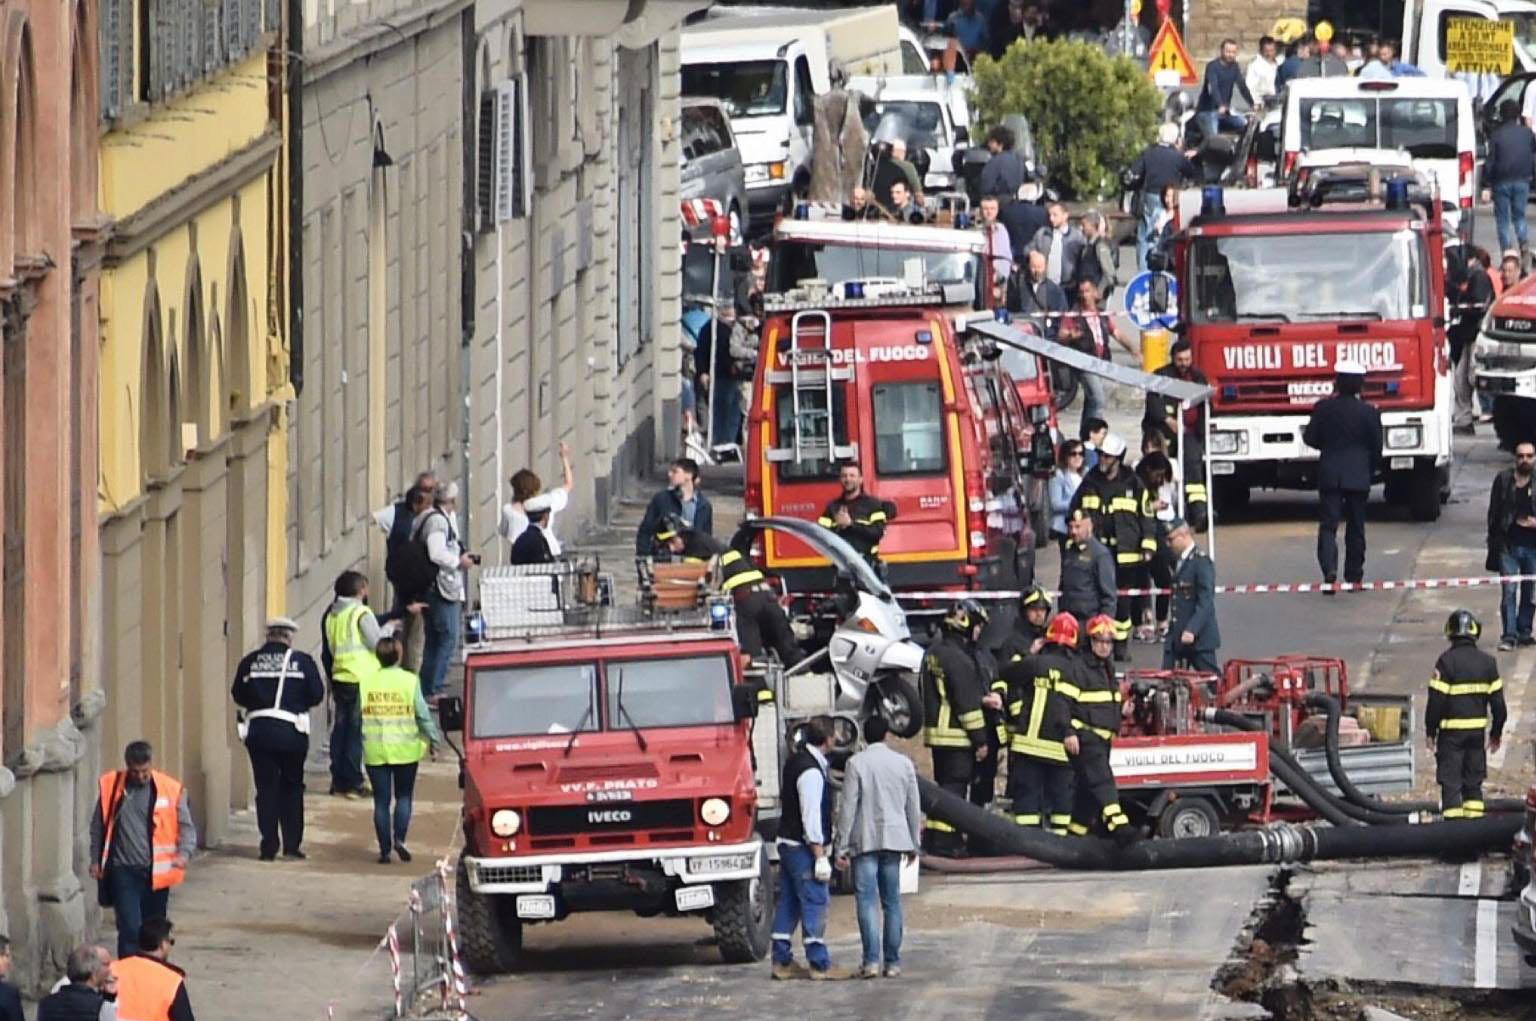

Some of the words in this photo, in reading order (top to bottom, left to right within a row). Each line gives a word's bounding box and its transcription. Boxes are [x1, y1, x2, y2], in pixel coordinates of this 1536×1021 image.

[830, 347, 866, 364] DEL
[869, 344, 929, 362] FUOCO
[1223, 344, 1283, 370] VIGILI
[1291, 342, 1328, 369] DEL
[1335, 341, 1396, 368] FUOCO
[1286, 381, 1335, 396] IVECO
[1124, 751, 1156, 767] VIGILI
[1160, 752, 1182, 766] DEL
[1185, 751, 1225, 764] FUOCO
[604, 778, 659, 791] PRATO
[587, 810, 632, 824] IVECO
